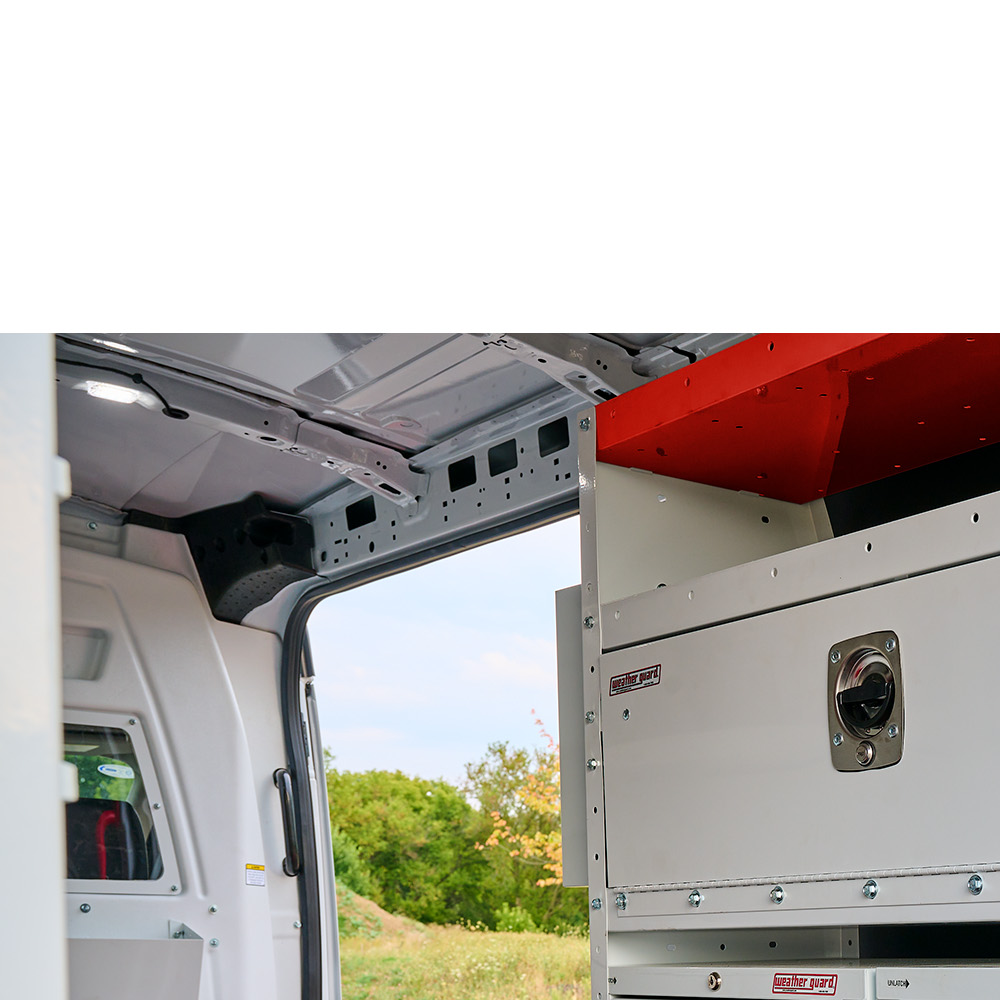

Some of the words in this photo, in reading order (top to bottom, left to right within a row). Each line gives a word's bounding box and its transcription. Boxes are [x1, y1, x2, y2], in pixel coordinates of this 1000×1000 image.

[612, 674, 638, 688] weather
[639, 667, 658, 684] guard
[775, 975, 807, 987] weather
[810, 976, 834, 990] guard
